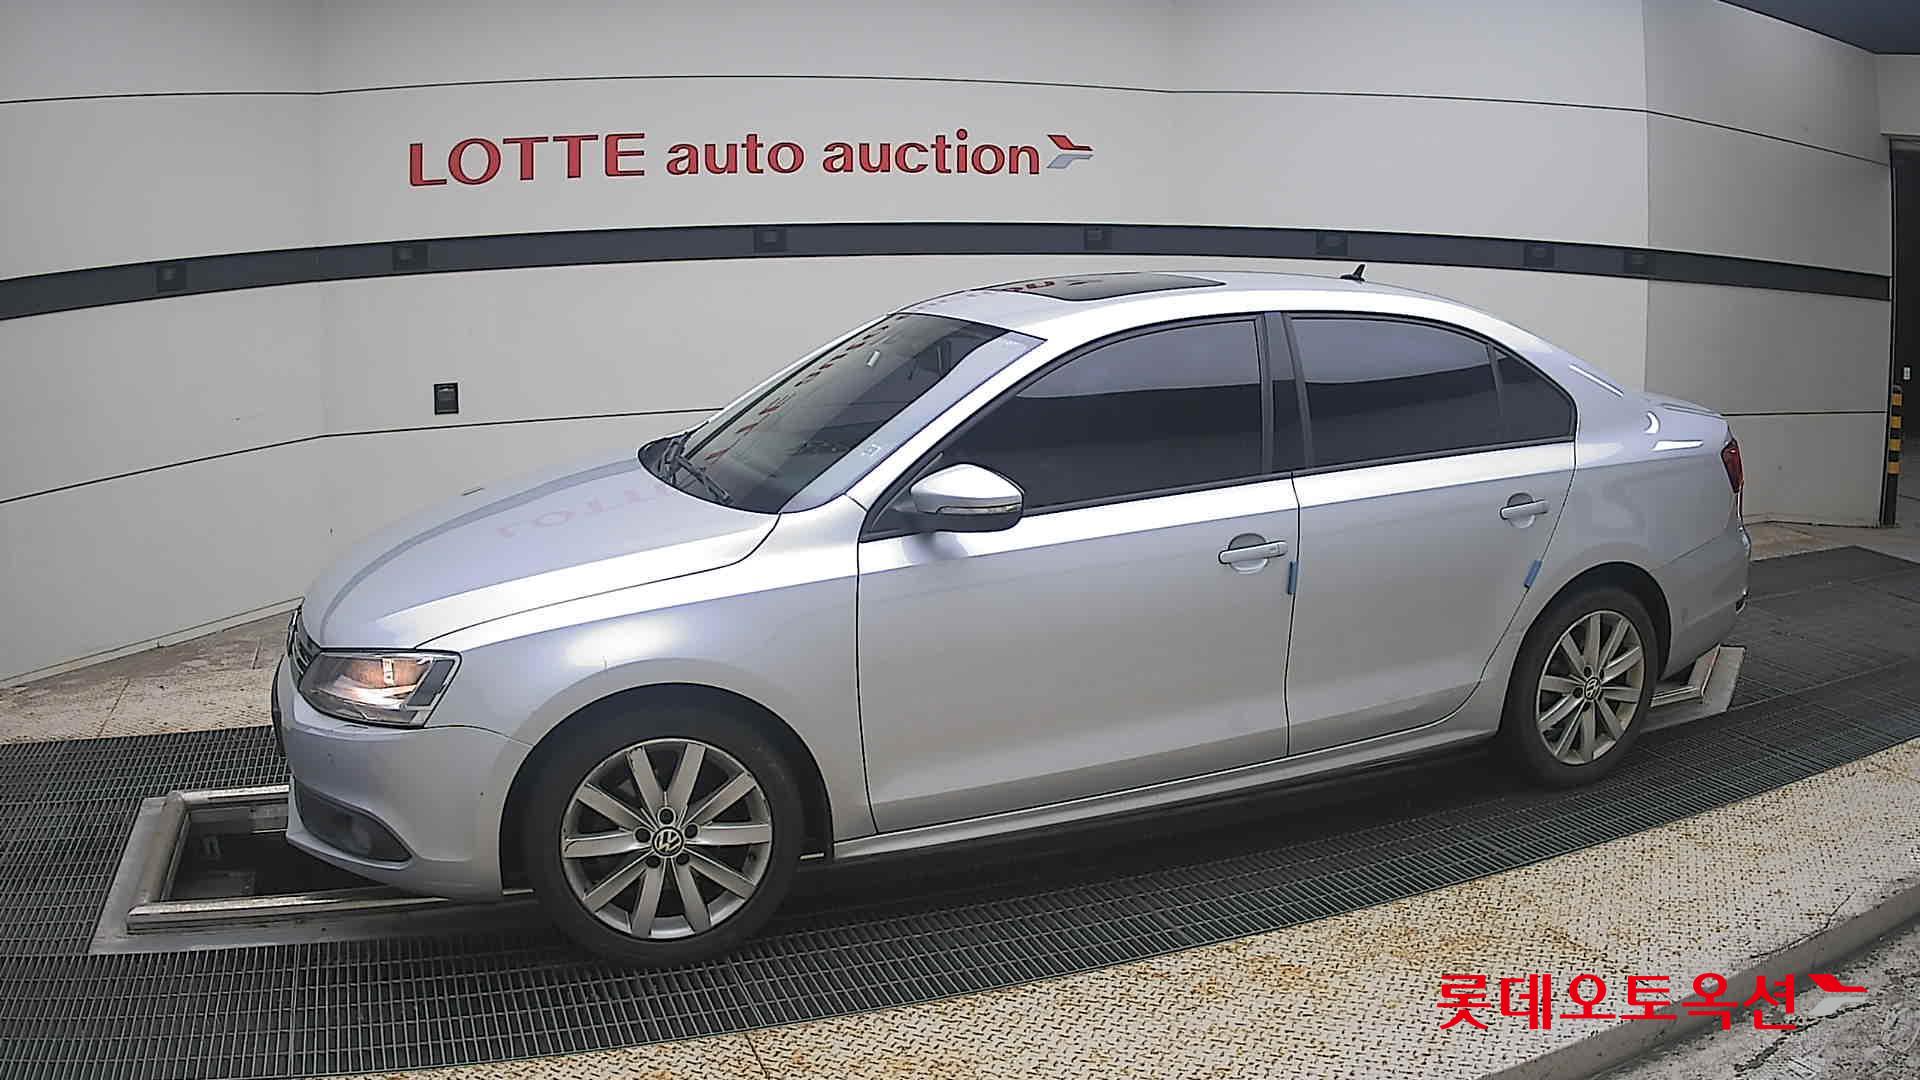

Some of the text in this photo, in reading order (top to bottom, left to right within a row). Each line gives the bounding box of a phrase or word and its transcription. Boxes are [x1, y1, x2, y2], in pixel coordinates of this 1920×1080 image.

[408, 128, 1041, 187] LOTTE auto auction
